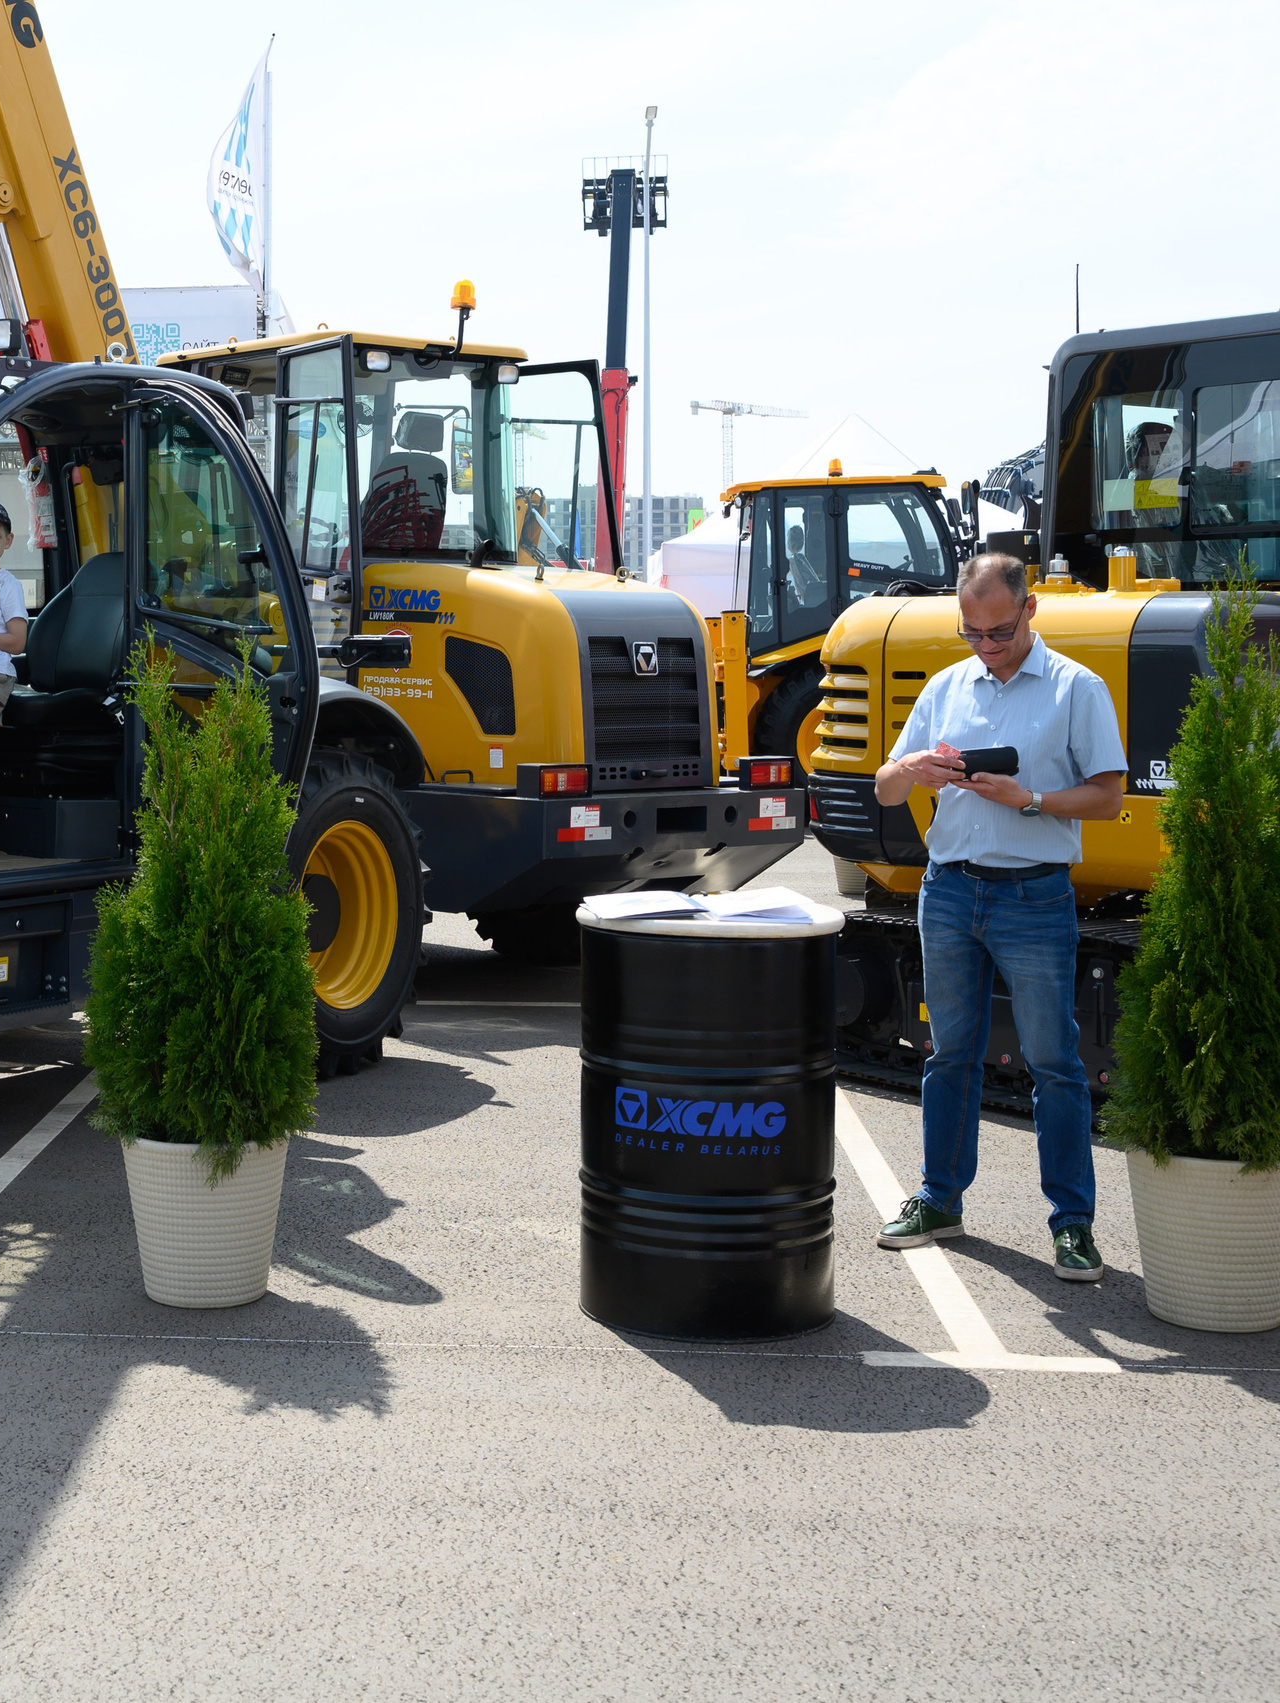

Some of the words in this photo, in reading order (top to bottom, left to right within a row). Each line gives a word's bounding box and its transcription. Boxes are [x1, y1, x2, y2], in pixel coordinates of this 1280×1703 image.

[52, 146, 137, 365] XC6-3007
[385, 588, 441, 611] XCMG
[647, 1097, 787, 1138] XCMG
[615, 1133, 685, 1153] DEALER
[700, 1144, 781, 1156] BELARUS
